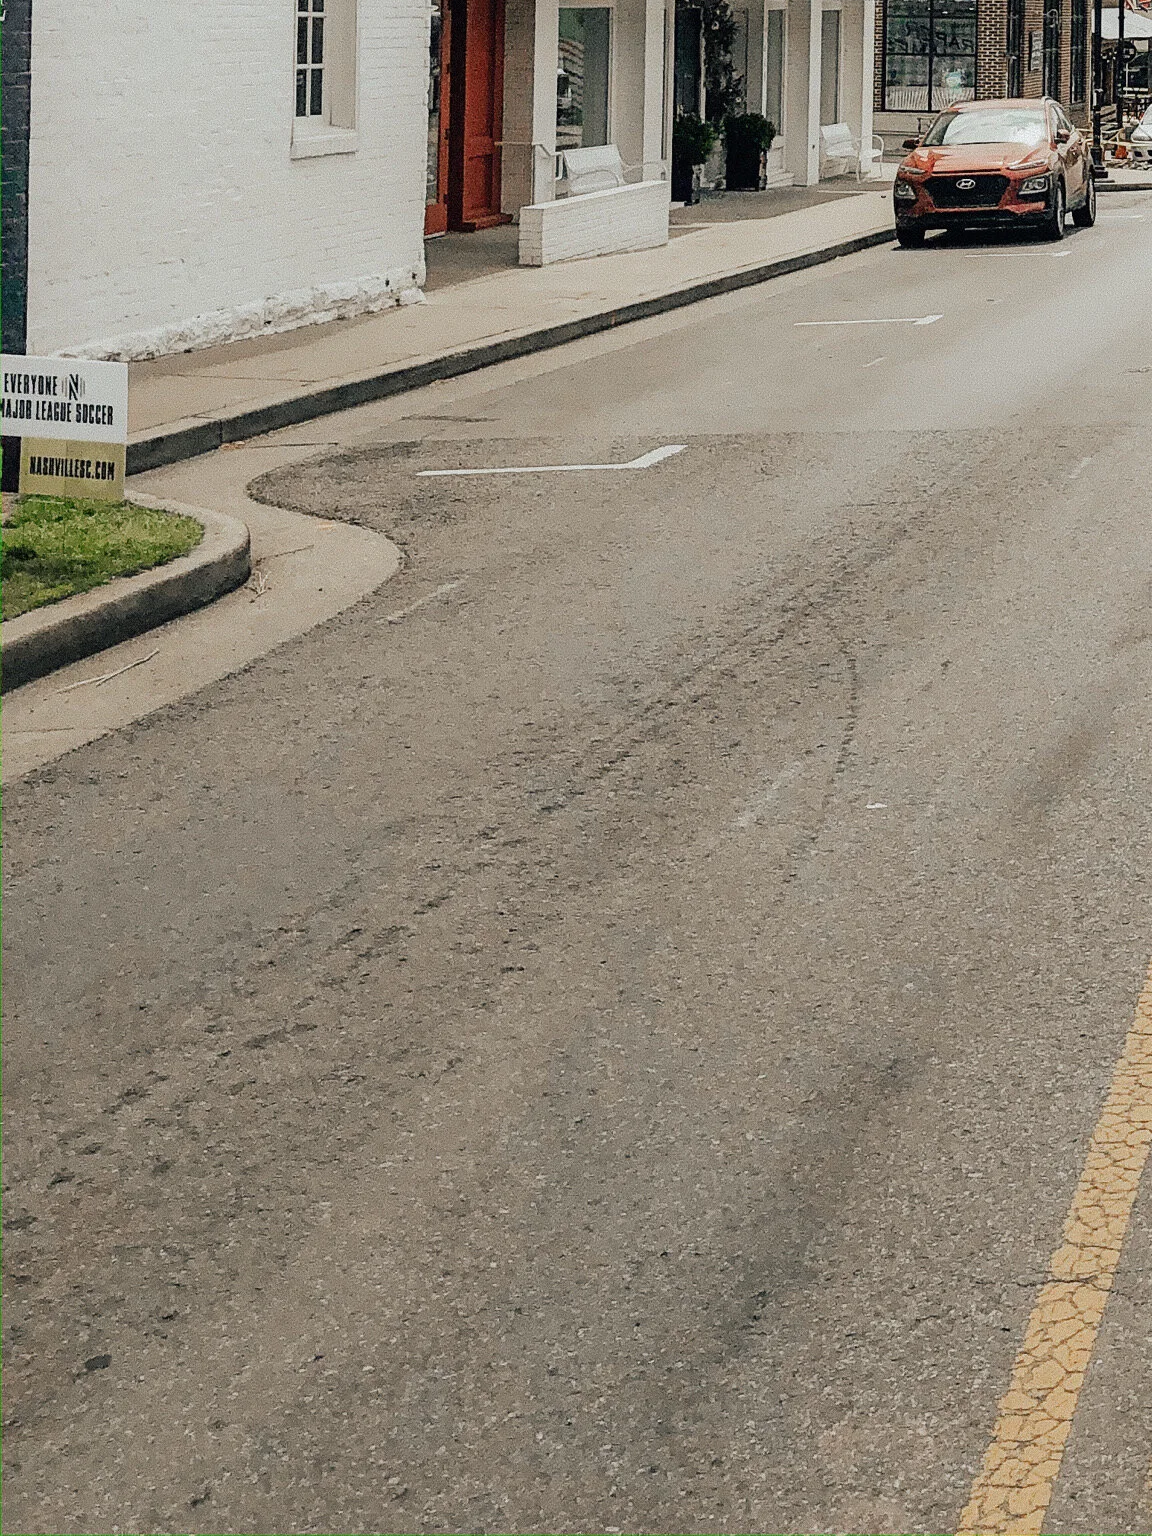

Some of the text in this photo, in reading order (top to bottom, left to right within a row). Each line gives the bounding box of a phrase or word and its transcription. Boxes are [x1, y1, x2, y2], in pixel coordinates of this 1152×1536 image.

[4, 372, 58, 396] EVERYONE
[35, 400, 72, 422] LEAGUE
[75, 403, 114, 425] SOCCER
[29, 456, 115, 481] NASHVILLESC.COM
